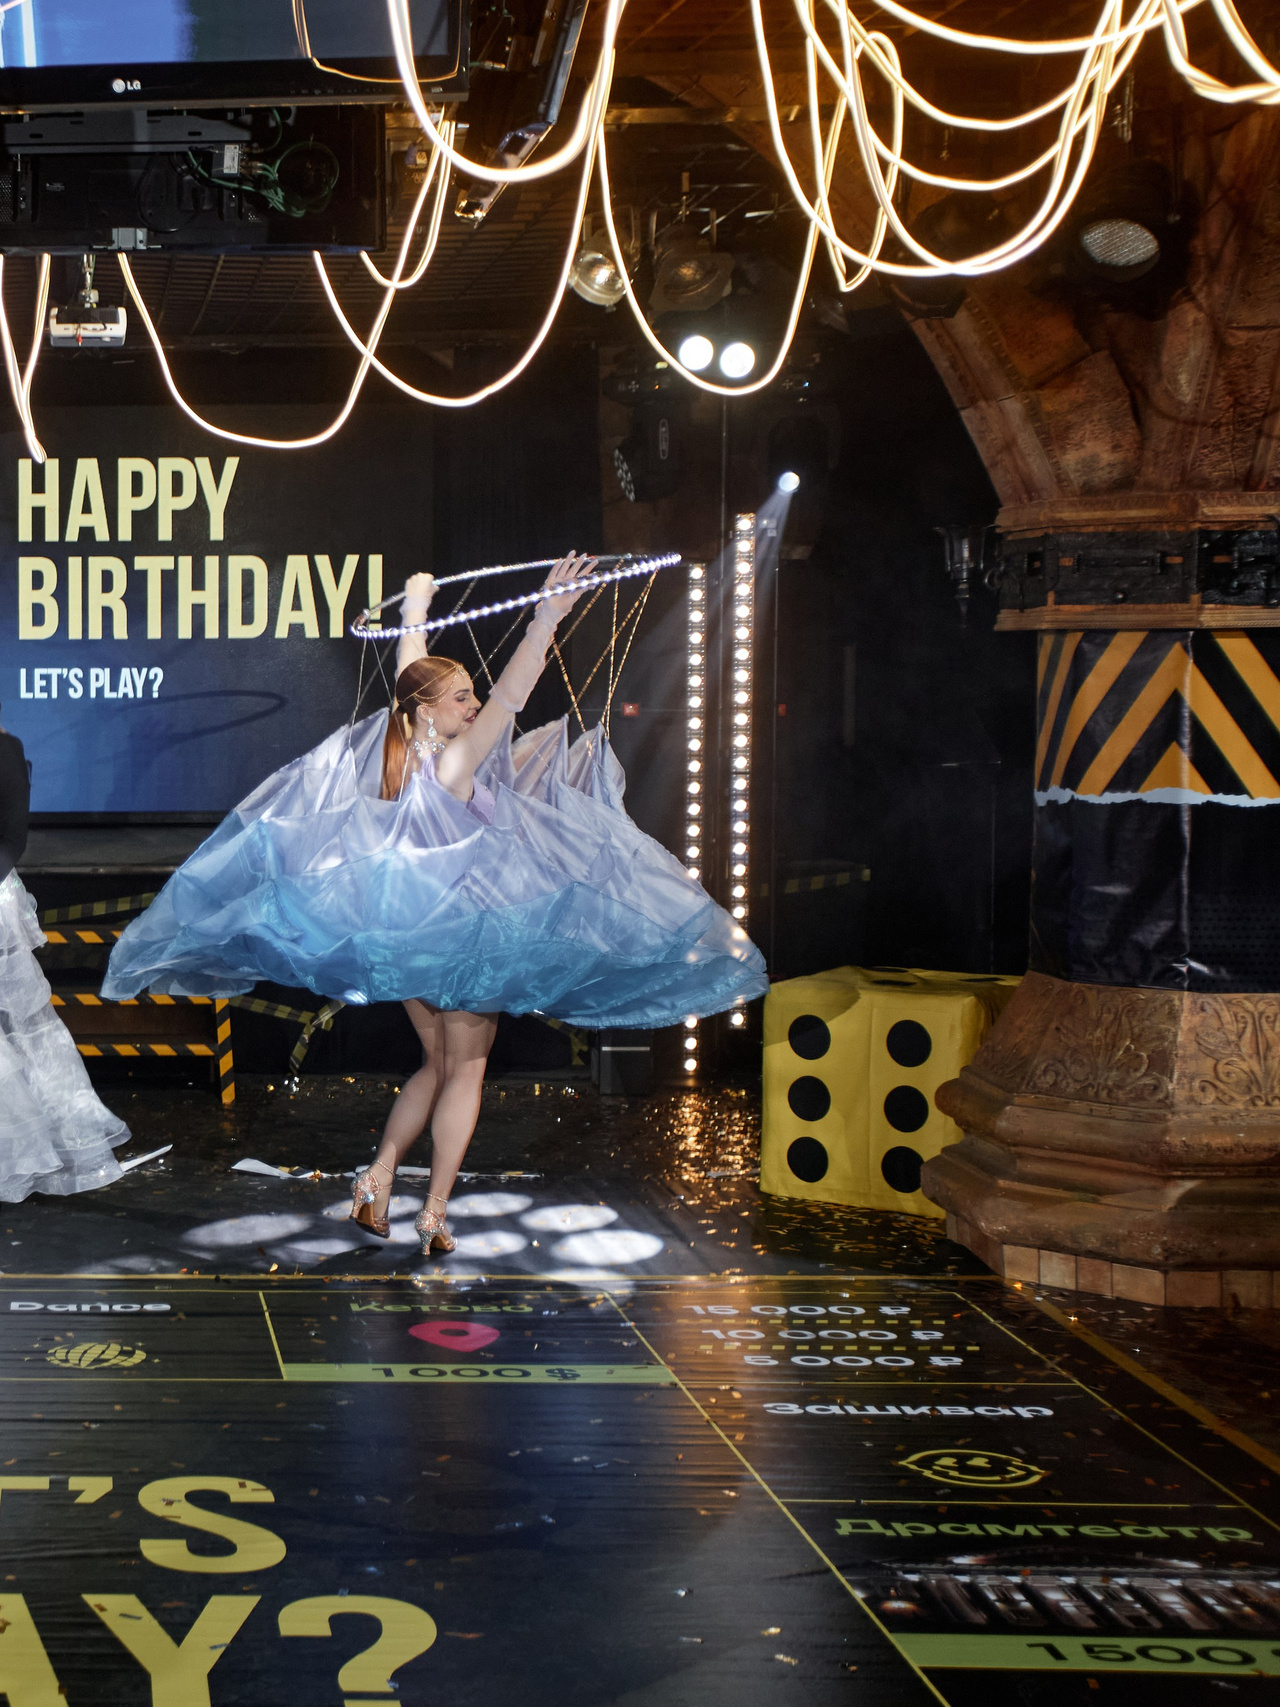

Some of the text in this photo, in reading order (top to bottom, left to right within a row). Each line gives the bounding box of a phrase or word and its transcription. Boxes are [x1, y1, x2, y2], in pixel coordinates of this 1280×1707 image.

[126, 80, 141, 91] LG
[18, 457, 240, 542] HAPPY
[18, 554, 384, 640] BIRTHDAY!
[89, 667, 164, 699] PLAY?
[10, 1301, 171, 1312] Dance
[349, 1302, 534, 1313] Кетово
[682, 1305, 740, 1315] 15
[750, 1305, 866, 1316] 000
[701, 1329, 766, 1340] 10
[778, 1329, 898, 1341] 000
[743, 1355, 780, 1366] 5
[790, 1355, 916, 1367] 000
[762, 1402, 1055, 1418] Зашквар
[834, 1518, 1254, 1543] Драмтеатр
